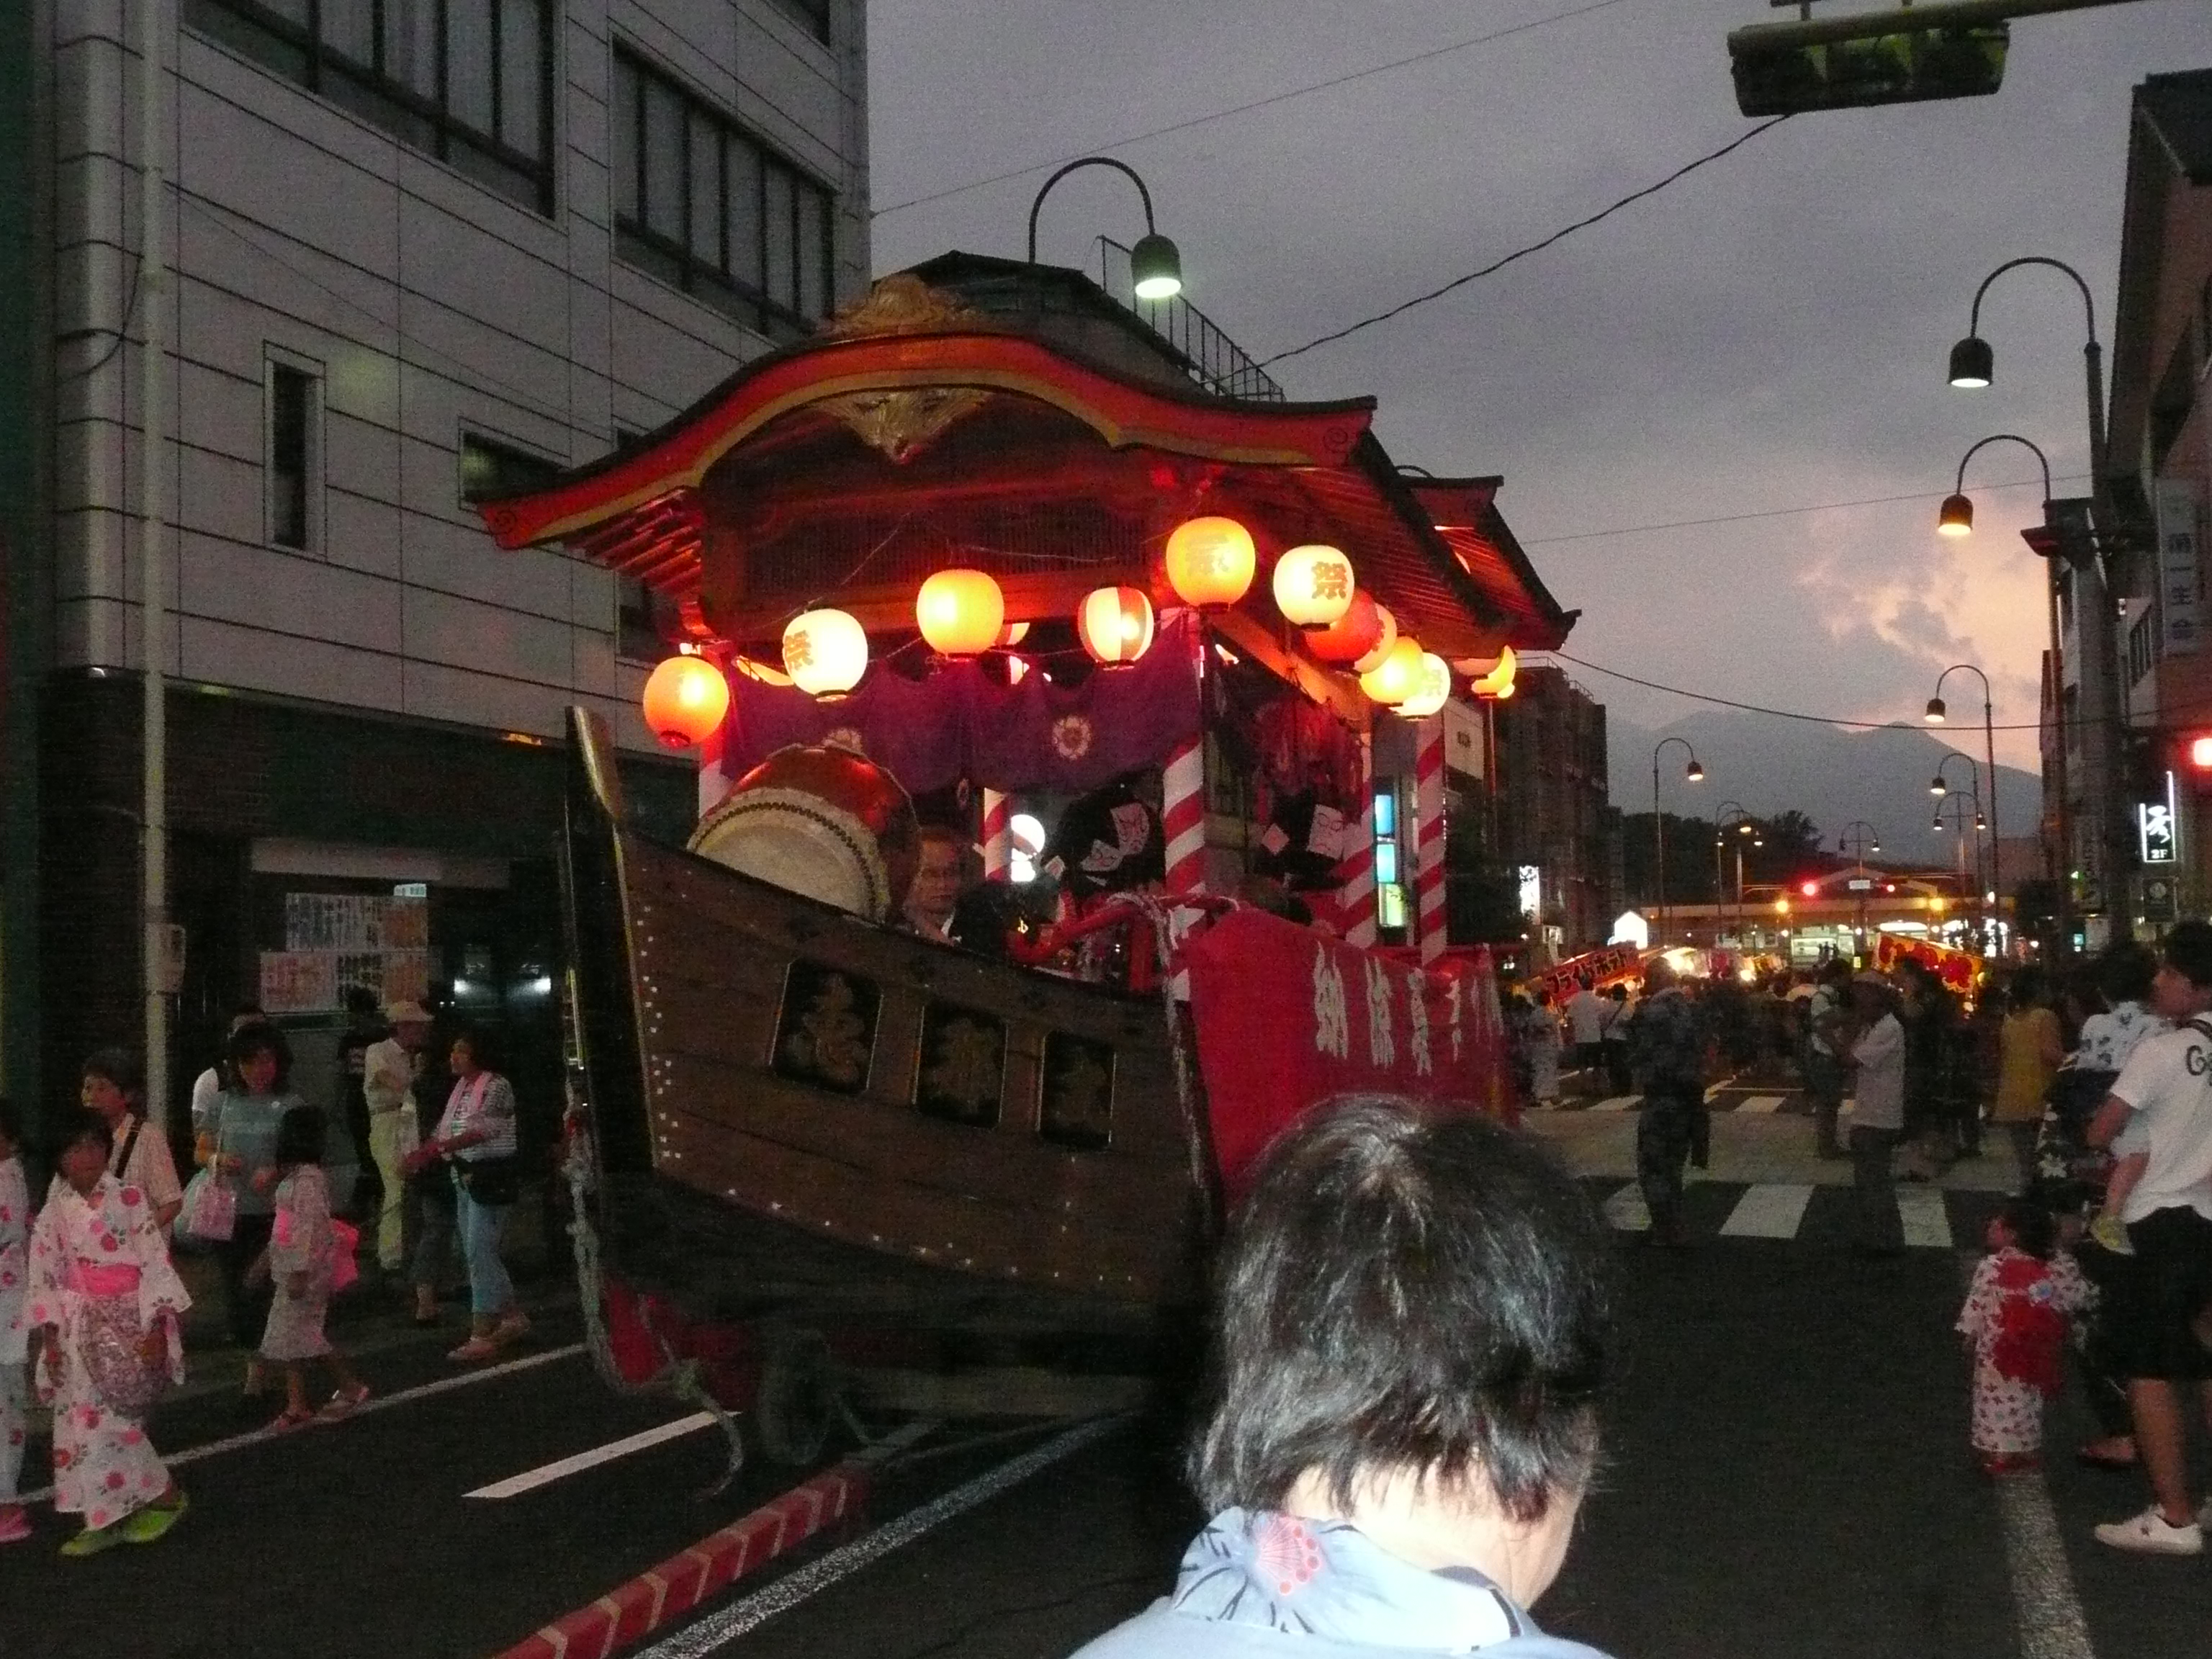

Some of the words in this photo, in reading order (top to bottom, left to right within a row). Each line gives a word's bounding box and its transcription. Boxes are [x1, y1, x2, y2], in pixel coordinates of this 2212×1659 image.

[1311, 561, 1349, 601] 祭
[783, 629, 815, 674] 祭
[2150, 849, 2168, 860] 2F
